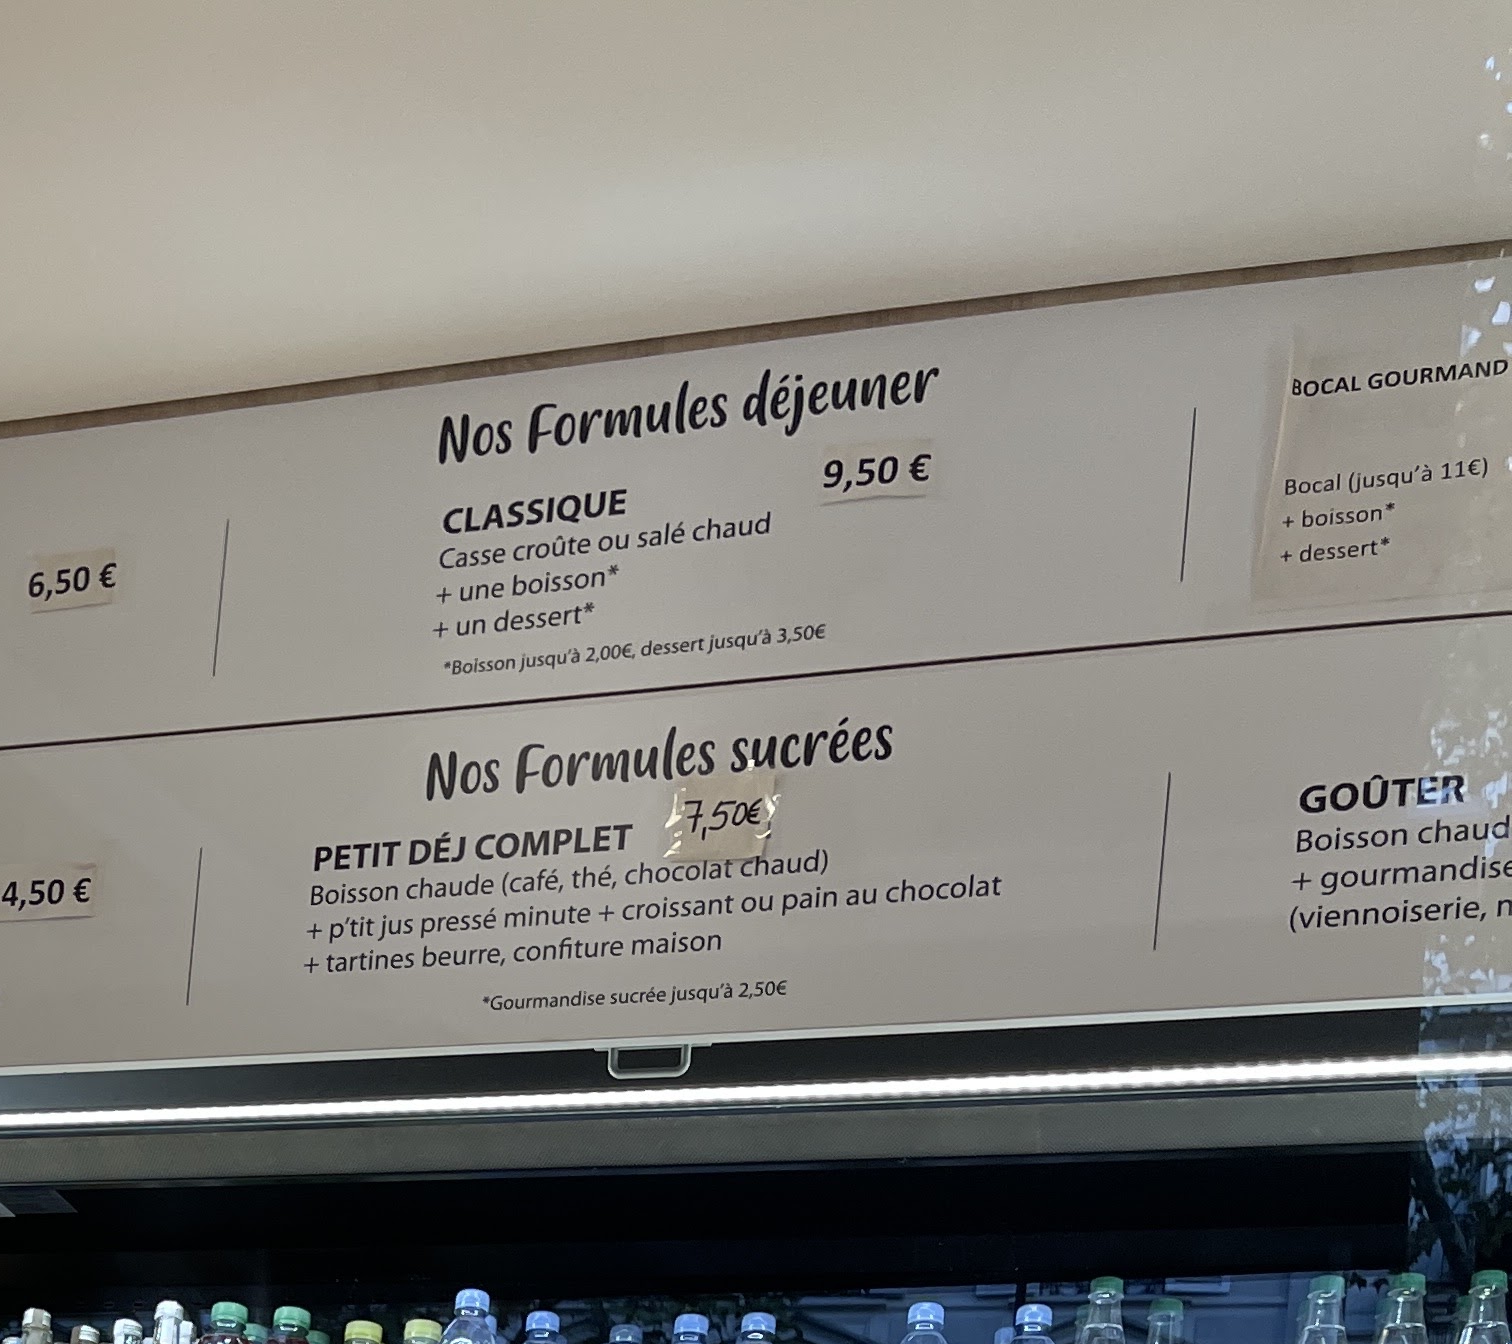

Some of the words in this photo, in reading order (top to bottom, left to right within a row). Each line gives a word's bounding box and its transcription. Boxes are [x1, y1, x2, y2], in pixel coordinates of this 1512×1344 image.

[1292, 376, 1361, 397] BOCAL
[1368, 360, 1508, 389] GOURMAND
[439, 414, 512, 464] Nos
[528, 380, 727, 454] Formules
[743, 367, 939, 436] déjeuner
[823, 456, 898, 493] 9,50
[909, 454, 931, 481] €
[1285, 473, 1340, 495] Bocal
[1349, 464, 1432, 493] (jusqu'à
[1441, 457, 1488, 479] 11€)
[443, 489, 628, 535] CLASSIQUE
[439, 548, 506, 569] Casse
[513, 535, 591, 561] croûte
[598, 534, 629, 552] ou
[637, 522, 685, 548] salé
[693, 511, 771, 541] chaud
[29, 566, 90, 601] 6,50
[99, 562, 117, 588] €
[460, 583, 504, 601] une
[457, 619, 486, 636] un
[519, 648, 580, 672] jusqu'à
[586, 643, 635, 663] 2,00€,
[641, 638, 705, 656] dessert
[707, 629, 771, 654] jusqu'à
[777, 624, 826, 644] 3,50€
[426, 751, 499, 801] Nos
[516, 726, 715, 794] Formules
[731, 717, 892, 773] sucrées
[1300, 775, 1464, 813] GOÛTER
[684, 798, 762, 841] 7,50€
[1297, 827, 1407, 853] Boisson
[1418, 815, 1510, 844] chaud
[314, 841, 401, 871] PETIT
[409, 832, 466, 865] DÉJ
[475, 824, 633, 860] COMPLET
[2, 879, 64, 911] 4,50
[73, 878, 91, 903] €
[311, 884, 398, 905] Boisson
[406, 873, 494, 899] chaude
[502, 869, 563, 897] (café,
[572, 865, 616, 890] thé,
[624, 857, 734, 885] chocolat
[740, 849, 829, 881] chaud)
[329, 916, 375, 944] p'tit
[378, 915, 413, 941] jus
[421, 908, 496, 939] pressé
[504, 906, 591, 928] minute
[623, 895, 734, 920] croissant
[741, 895, 773, 913] ou
[782, 887, 837, 916] pain
[846, 888, 877, 906] au
[886, 874, 1002, 903] chocolat
[1290, 896, 1486, 933] (viennoiserie,
[326, 943, 415, 972] tartines
[422, 946, 505, 967] beurre,
[514, 937, 623, 962] confiture
[632, 932, 721, 955] maison
[610, 987, 666, 1004] sucrée
[669, 983, 732, 1005] jusqu'à
[738, 980, 787, 999] 2,50€
